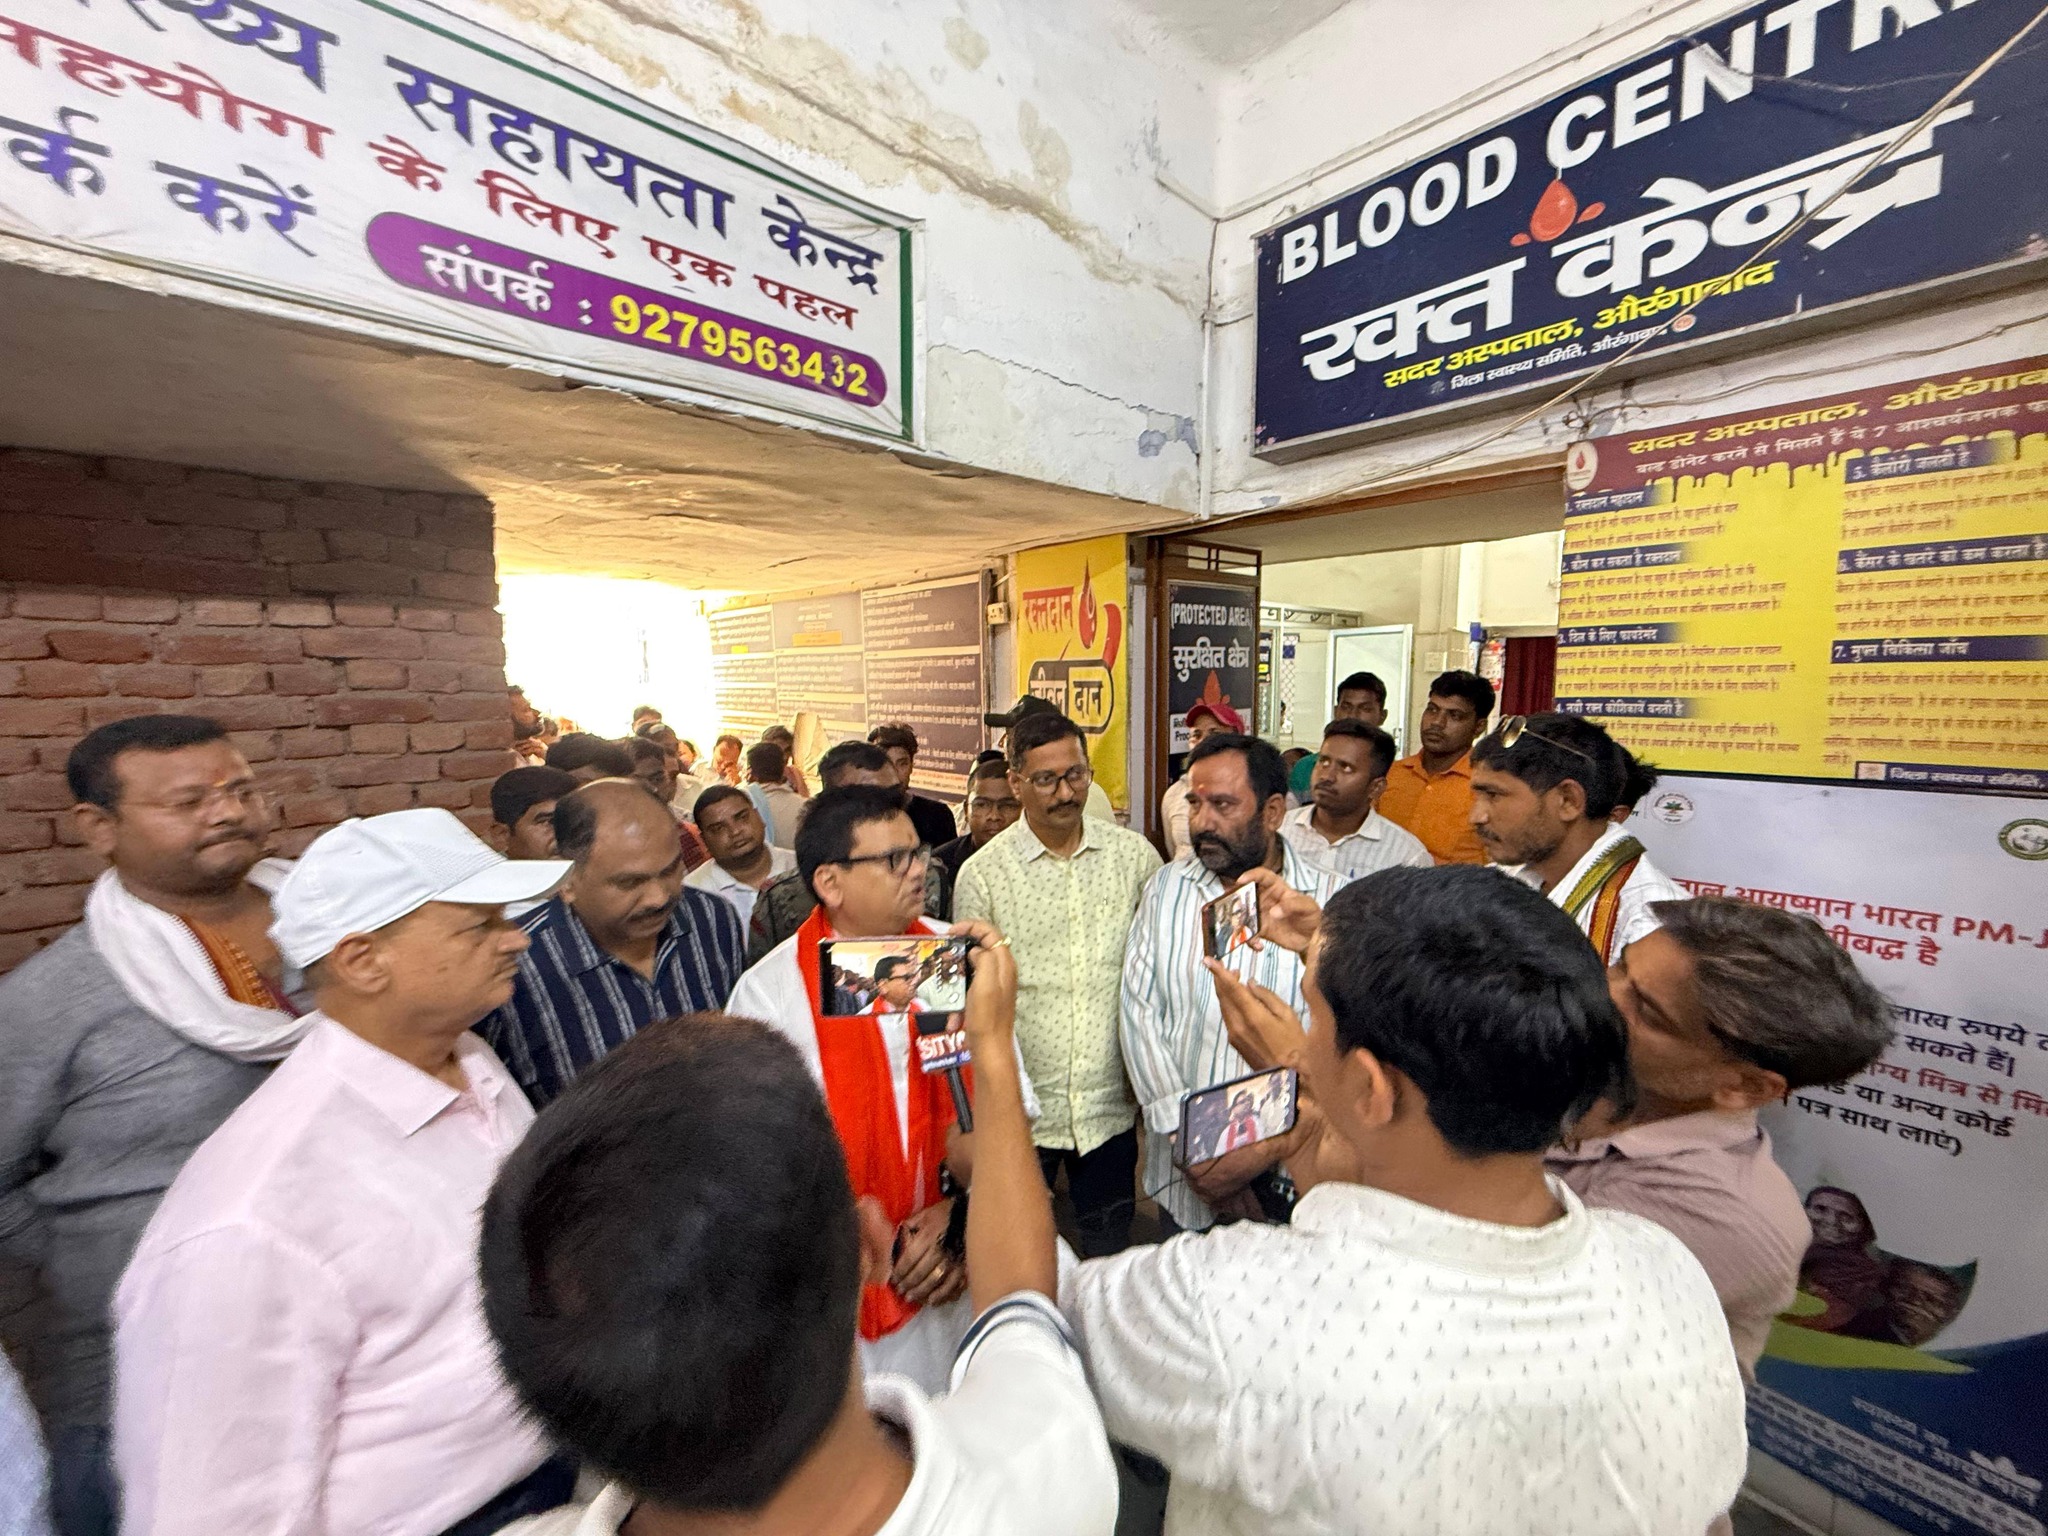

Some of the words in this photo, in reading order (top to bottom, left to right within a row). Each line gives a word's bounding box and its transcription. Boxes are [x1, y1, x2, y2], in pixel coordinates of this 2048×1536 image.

[1281, 135, 1518, 285] BLOOD
[1547, 0, 1975, 169] CENTR
[385, 54, 735, 240] सहायता
[761, 194, 885, 295] केन्द्र
[151, 163, 318, 258] करें
[366, 134, 448, 192] के
[475, 169, 620, 259] लिए
[641, 235, 737, 288] एक
[754, 274, 859, 331] पहल
[419, 243, 556, 313] संपर्क
[610, 294, 869, 398] 9279563432
[1302, 257, 1527, 381] रक्त
[1384, 355, 1446, 389] सदर
[1446, 317, 1584, 373] अस्पताल,
[1592, 260, 1781, 330] औरंगाबाद
[1536, 342, 1588, 369] समिति,
[1628, 430, 1700, 455] सदर
[1712, 446, 1749, 463] करने
[1753, 442, 1769, 457] से
[1872, 424, 1889, 438] 7
[1022, 586, 1075, 636] रक्तदान
[1170, 603, 1228, 630] (PROTECTED
[1172, 636, 1226, 683] सुरक्षित
[1227, 637, 1251, 669] क्षेत्र
[1833, 644, 1847, 658] 7.
[1073, 680, 1104, 719] दान
[1863, 903, 1944, 934] भारत
[1826, 924, 1908, 961] ीबद्ध
[1916, 934, 1942, 967] है
[1904, 1034, 1979, 1065] सकते
[1958, 1018, 2028, 1047] रुपये
[1916, 1067, 1970, 1097] मित्र
[1976, 1083, 2003, 1106] से
[1796, 1094, 1834, 1120] पत्र
[1838, 1106, 1893, 1135] साथ
[1853, 1084, 1886, 1106] या
[1891, 1093, 1949, 1122] अन्य
[1953, 1109, 2017, 1138] कोई
